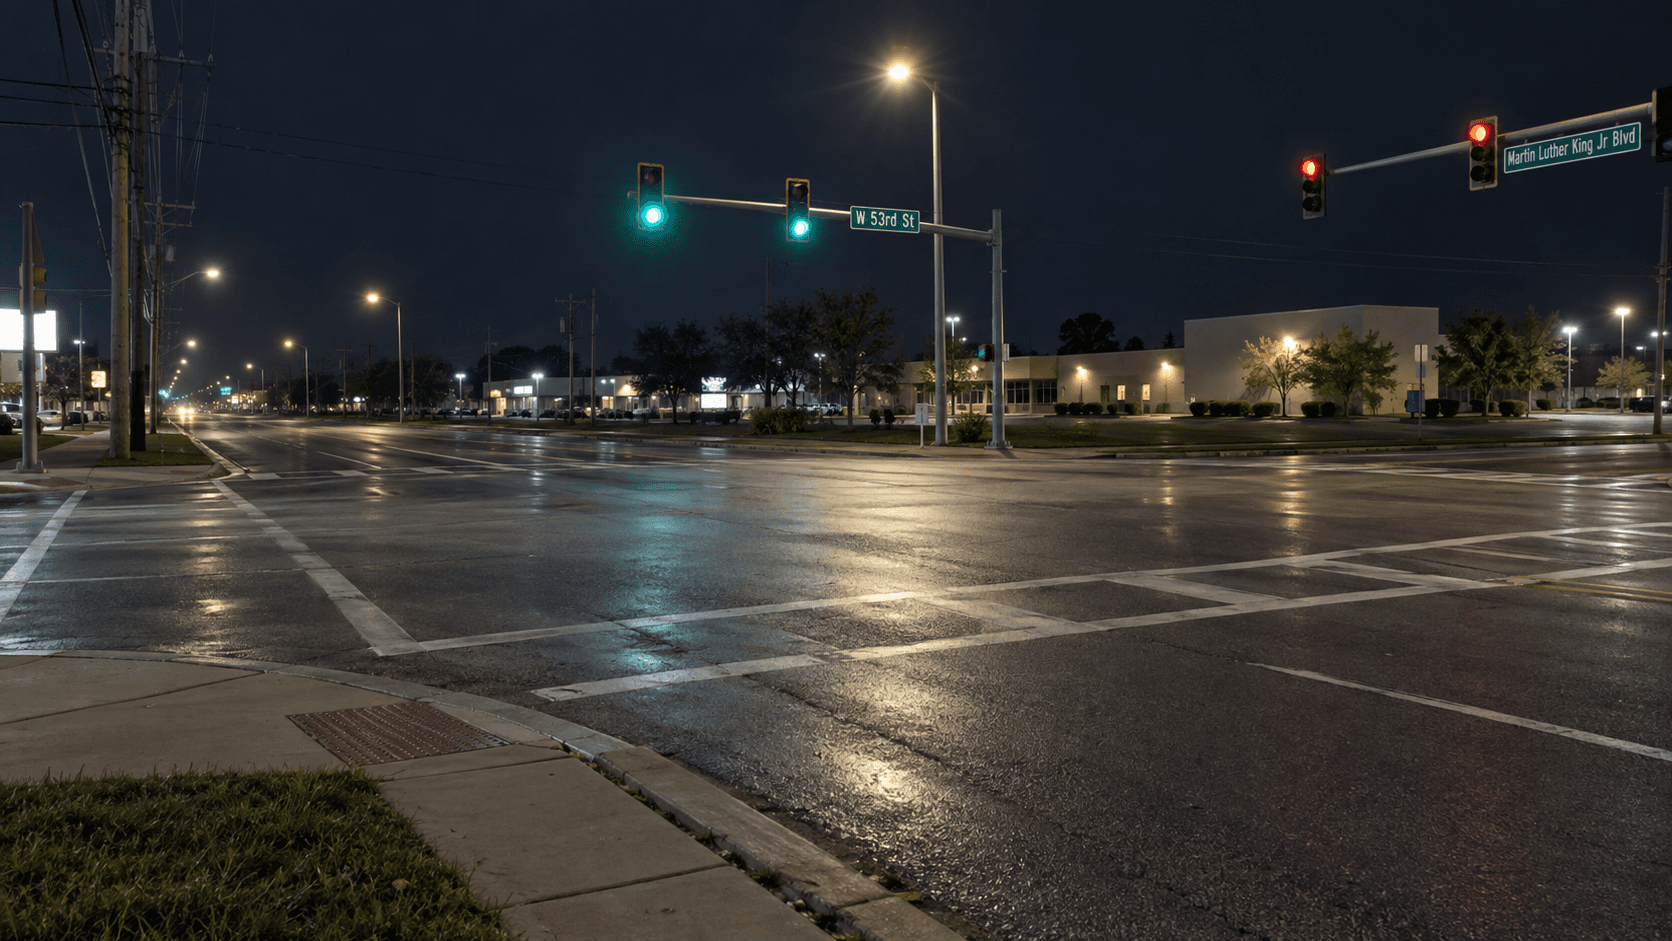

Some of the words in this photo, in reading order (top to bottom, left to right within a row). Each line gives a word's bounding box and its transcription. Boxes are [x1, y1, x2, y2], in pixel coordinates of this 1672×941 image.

[1508, 148, 1535, 166] Martin
[1539, 143, 1569, 161] Luther
[1572, 138, 1593, 155] King
[1597, 133, 1608, 150] Jr
[1613, 127, 1636, 147] Blvd
[856, 210, 866, 225] W
[870, 211, 897, 227] 53rd
[902, 213, 915, 228] St
